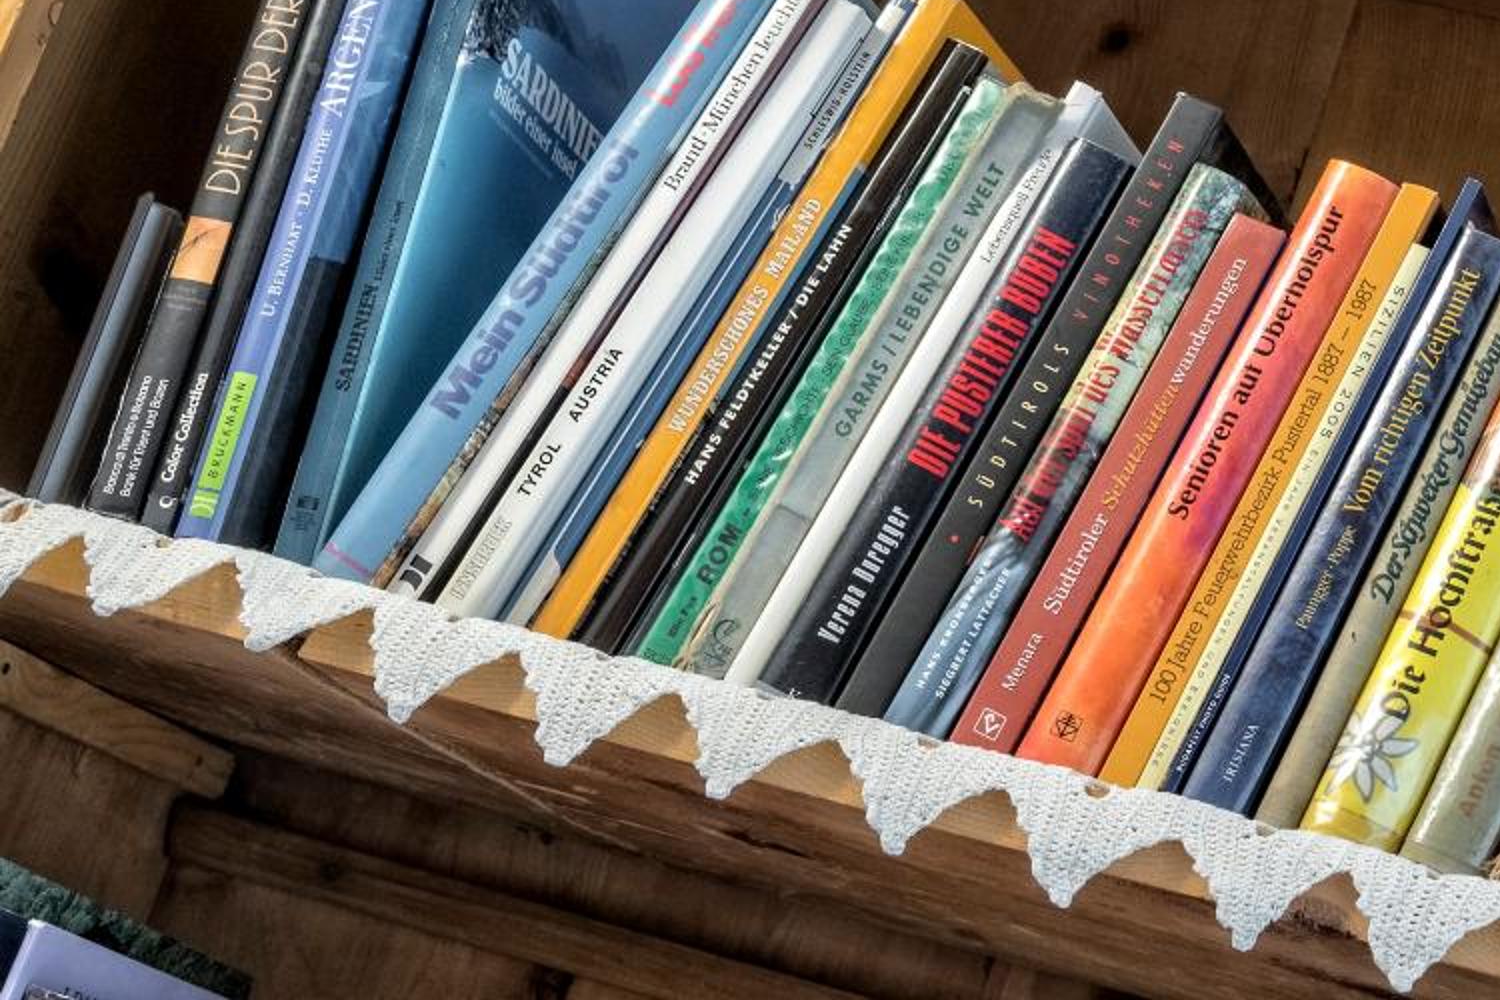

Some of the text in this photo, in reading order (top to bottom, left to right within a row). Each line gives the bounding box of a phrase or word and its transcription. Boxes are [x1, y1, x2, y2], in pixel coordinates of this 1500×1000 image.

[222, 55, 280, 144] SPUR
[699, 46, 765, 135] München
[802, 48, 873, 151] SCHLESWIG-HOLSTEIN
[204, 138, 252, 201] DIE
[428, 298, 526, 424] Mein
[502, 133, 641, 312] Südtirol
[761, 193, 825, 282] MAILAND
[995, 220, 1077, 319] BUBEN
[334, 282, 379, 393] SARDINIEN
[830, 356, 890, 442] GARMS
[883, 221, 970, 348] LEBENDIGE
[959, 157, 1007, 222] WELT
[963, 134, 1188, 510] SÜDTIROLS VINOTHEKEN
[1348, 282, 1405, 380] SIZILIEN
[1411, 262, 1485, 374] Zeitpunkt
[682, 220, 854, 487] HANS FELDTKELLER DIE LAHN
[927, 302, 1032, 440] PUSTERER
[159, 369, 209, 485] Color Collection
[205, 379, 248, 480] BRUCKMANN
[515, 342, 624, 501] TYROL AUSTRIA
[903, 422, 962, 482] DIE
[1165, 359, 1263, 522] Senioren auf
[1317, 386, 1353, 442] 2005
[1366, 366, 1434, 469] richtigen
[1147, 276, 1378, 705] 100 Jahre Feuerwehrbezirk Pustertal 1887 1987
[1341, 462, 1383, 520] Vom
[1386, 448, 1459, 560] Schweizer
[694, 520, 744, 587] ROM
[815, 502, 914, 648] Verena Duregger
[1325, 522, 1359, 568] Poppe
[1363, 548, 1410, 607] Der
[997, 509, 1110, 693] Menara Südtiroler
[932, 638, 973, 699] SIEGBERT
[1377, 660, 1427, 724] Die
[1220, 720, 1260, 784] IRISIANA
